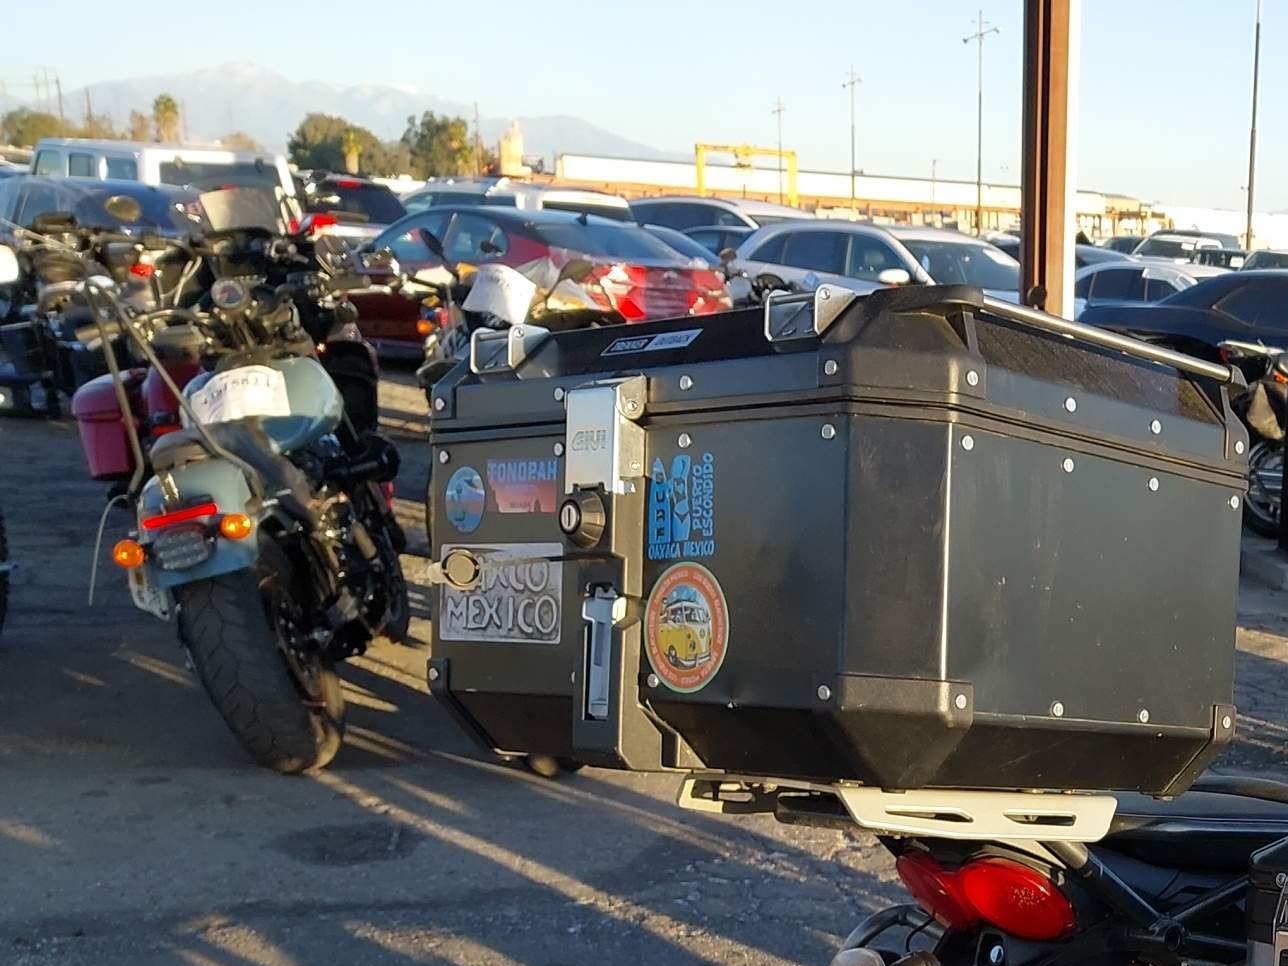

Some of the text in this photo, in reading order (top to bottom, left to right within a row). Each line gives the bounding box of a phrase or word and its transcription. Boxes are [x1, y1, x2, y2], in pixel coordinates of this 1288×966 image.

[571, 429, 608, 452] GIVI
[488, 459, 557, 481] TONOPAH
[692, 464, 703, 530] PUERTO
[702, 452, 714, 537] ESCONDIDO
[683, 539, 715, 557] MEXICO
[446, 594, 558, 634] MEXICO
